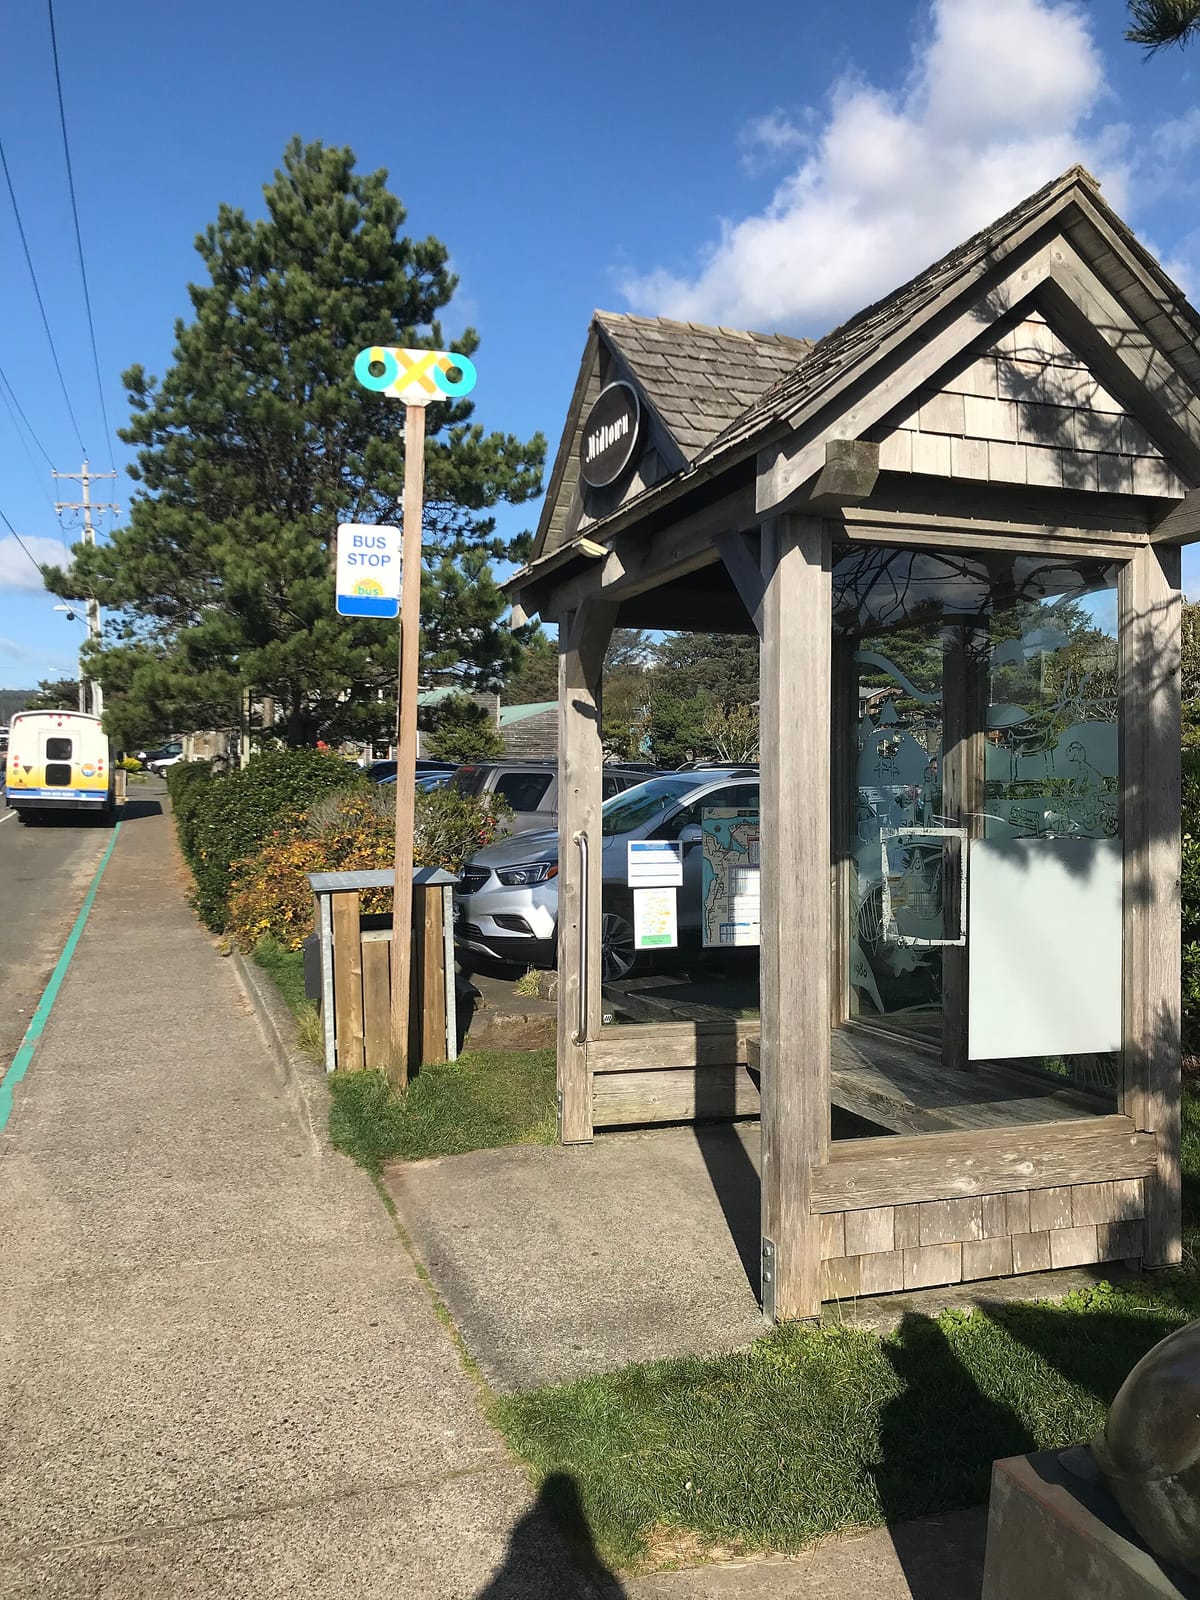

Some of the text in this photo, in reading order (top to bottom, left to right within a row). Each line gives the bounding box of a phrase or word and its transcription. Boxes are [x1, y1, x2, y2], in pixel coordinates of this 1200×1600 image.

[353, 535, 387, 549] BUS
[347, 553, 391, 567] STOP
[357, 585, 379, 596] bus
